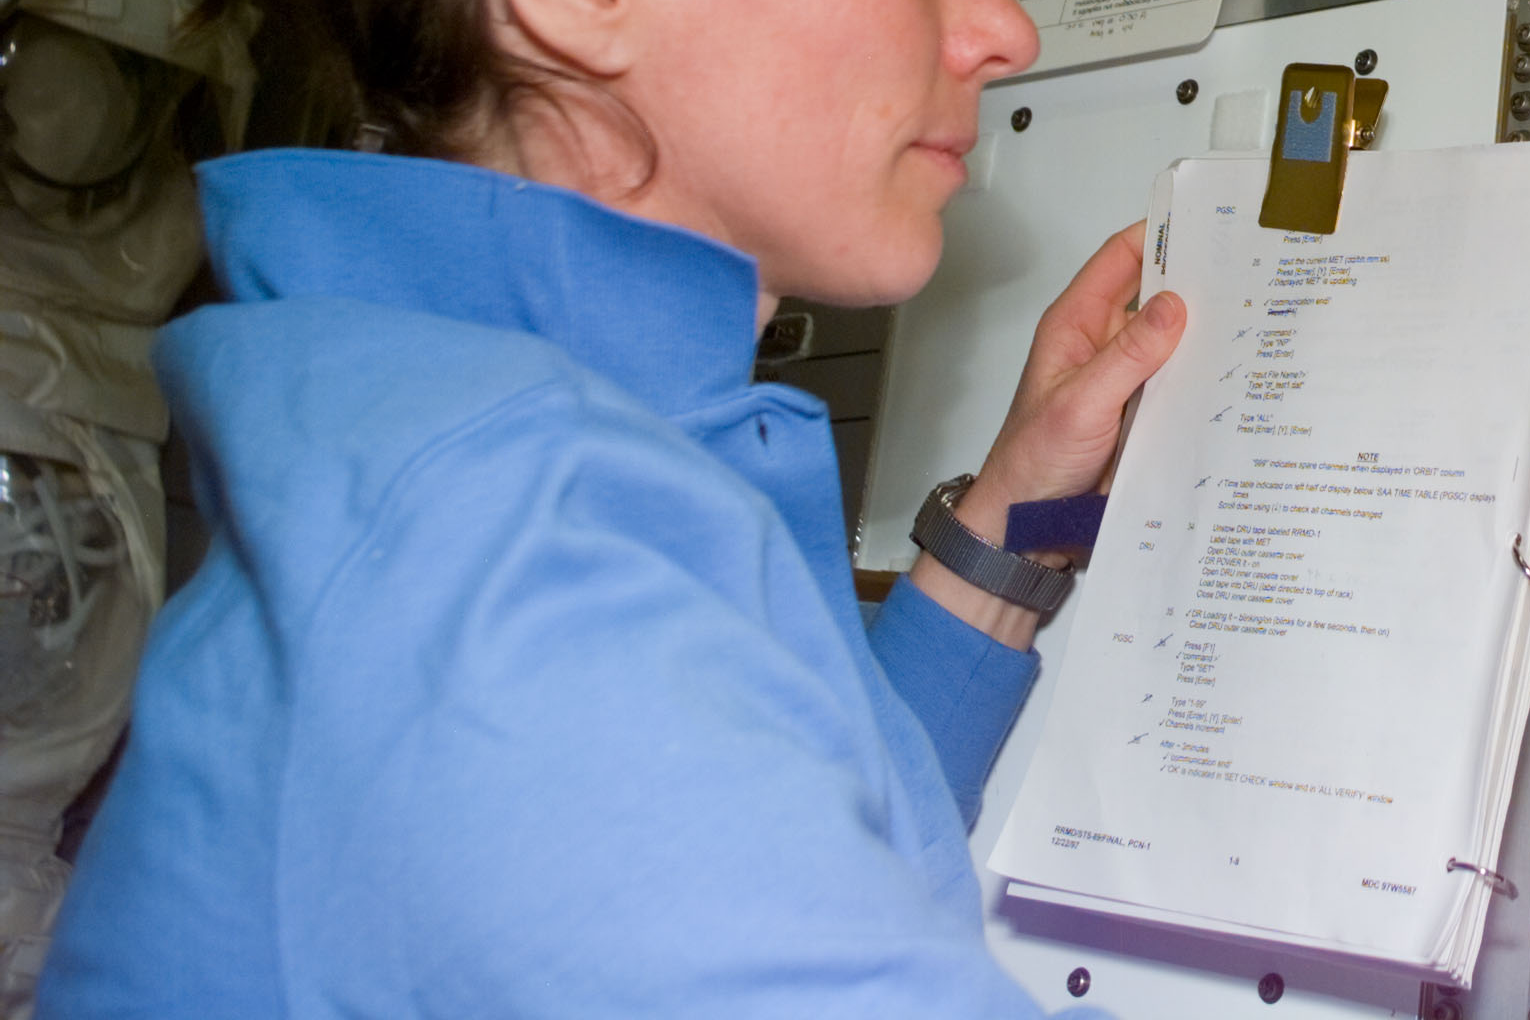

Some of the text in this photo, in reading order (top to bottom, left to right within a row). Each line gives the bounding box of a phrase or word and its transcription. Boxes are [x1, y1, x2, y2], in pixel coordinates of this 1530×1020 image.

[1216, 206, 1236, 215] PGSC
[1155, 223, 1165, 264] NOMINAL
[1357, 452, 1380, 461] NOTE
[1414, 490, 1439, 500] TABLE
[1218, 501, 1235, 510] Scroll
[1362, 878, 1380, 890] MDC
